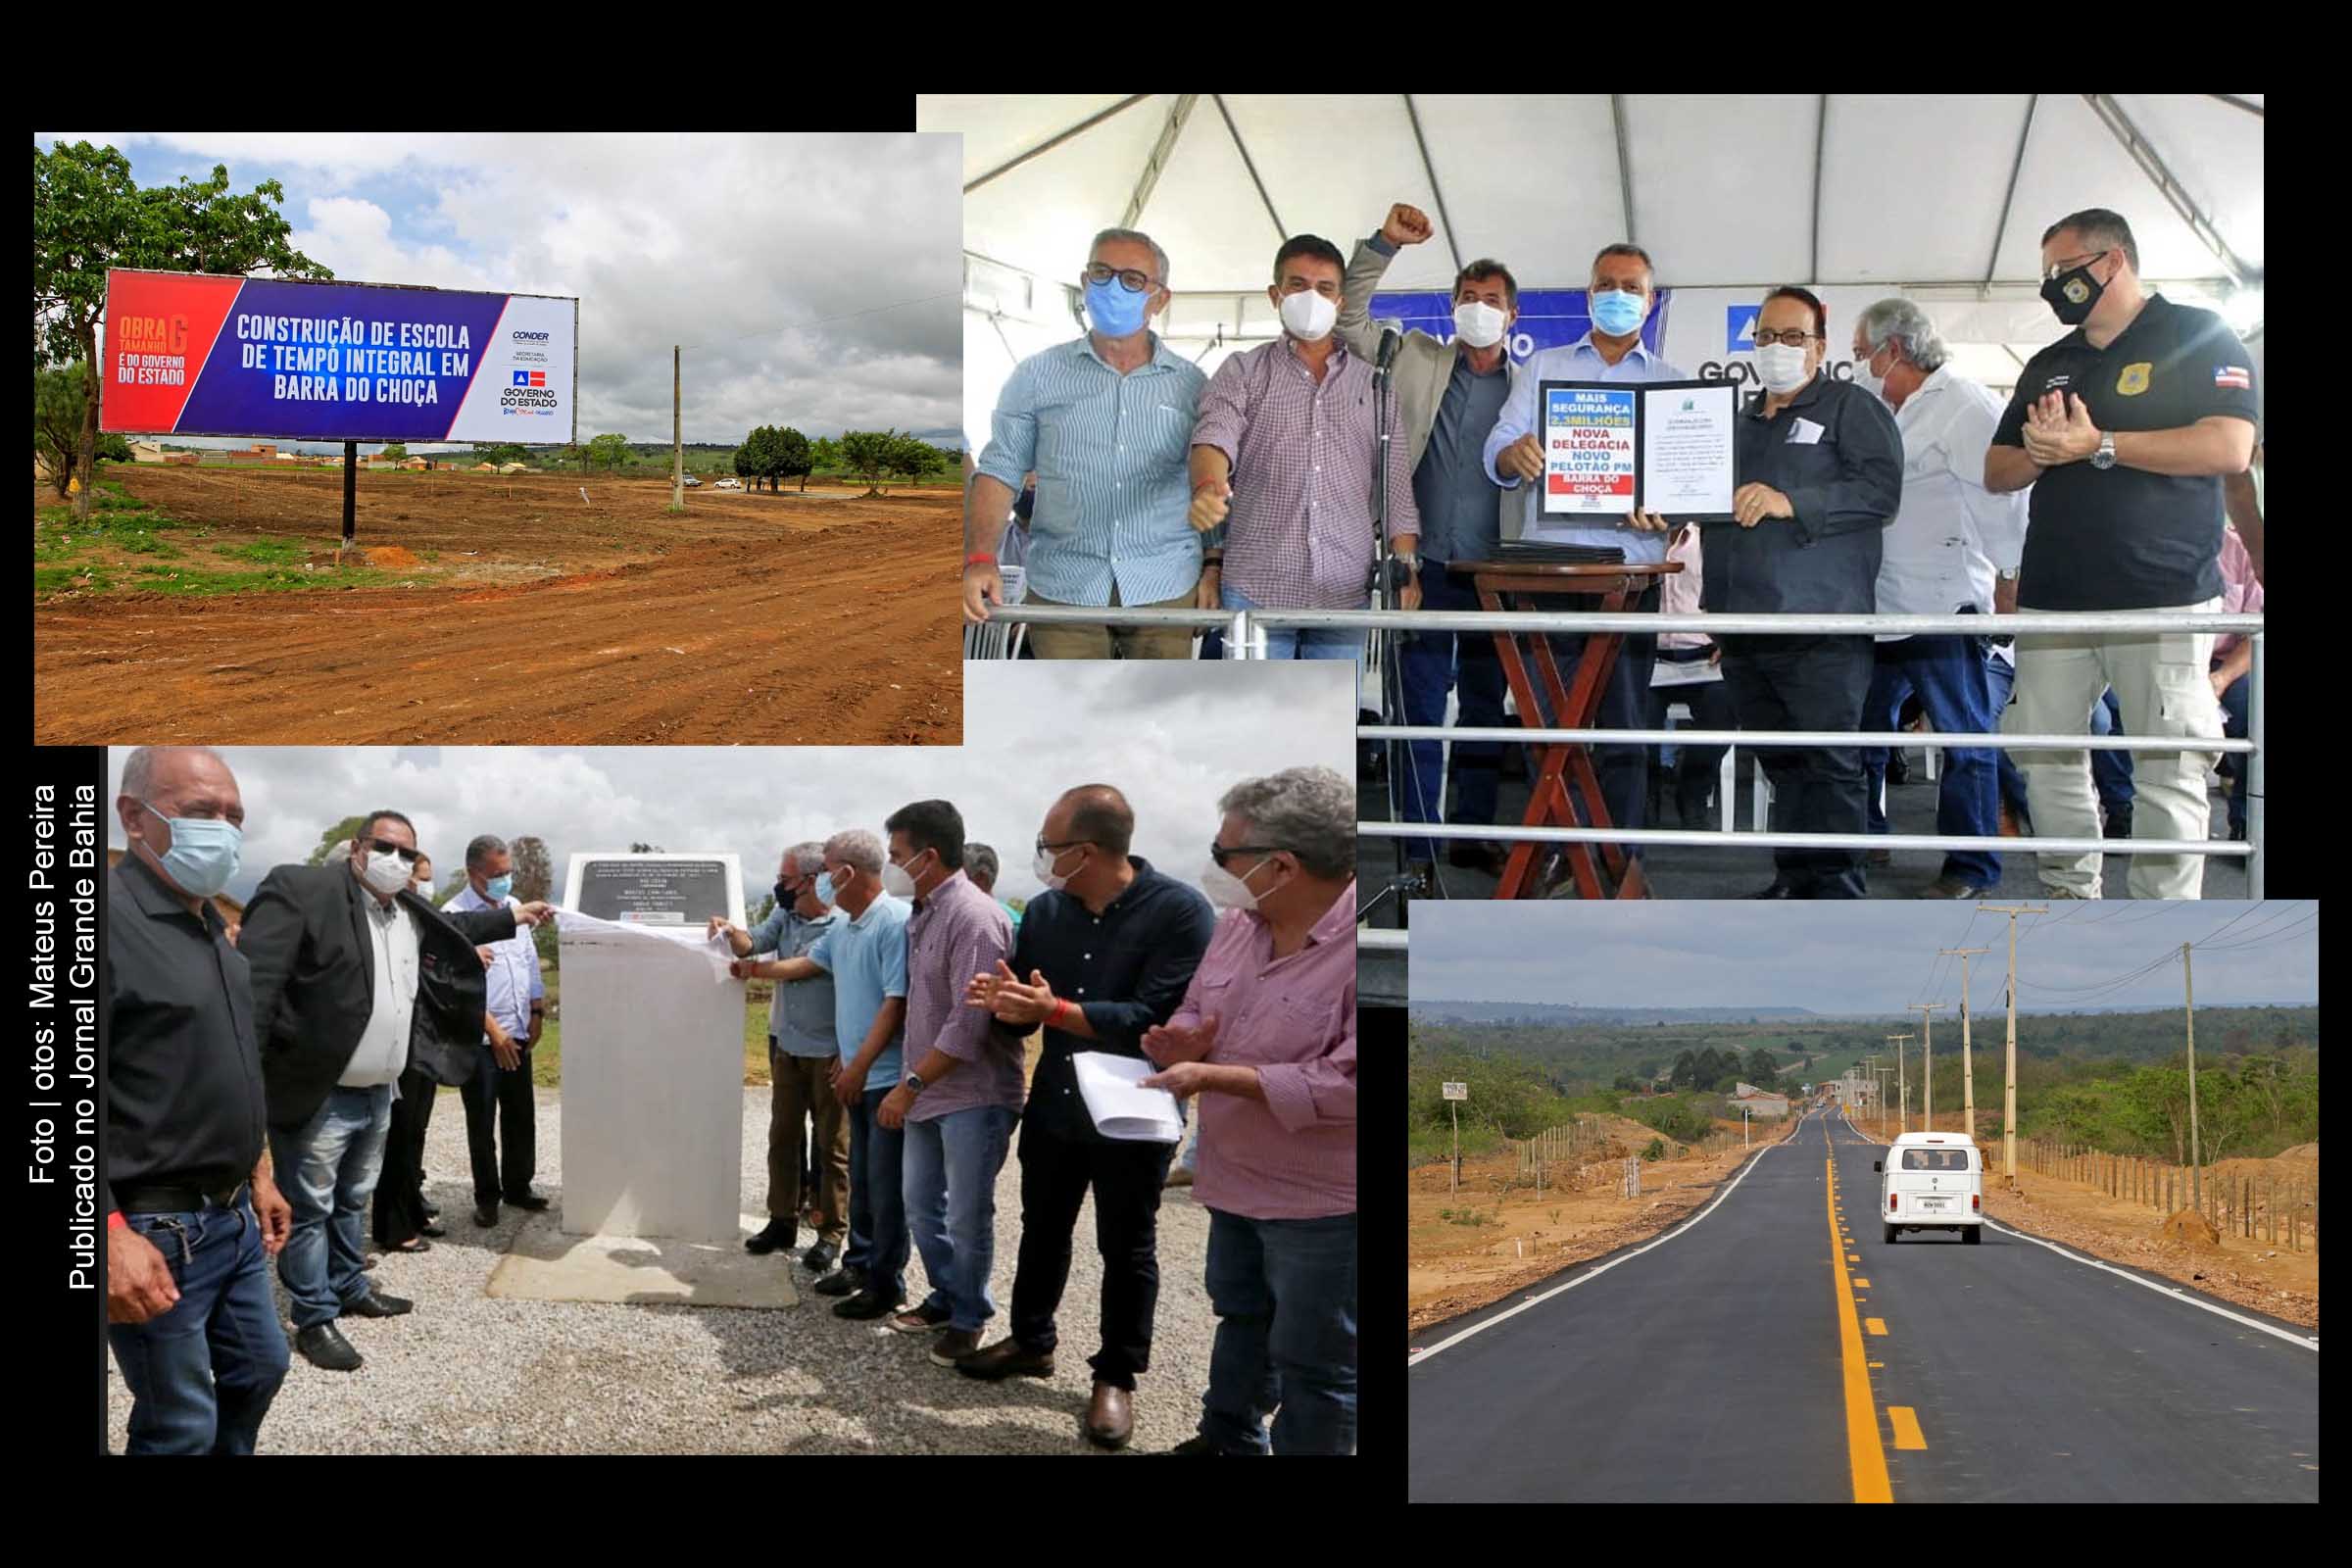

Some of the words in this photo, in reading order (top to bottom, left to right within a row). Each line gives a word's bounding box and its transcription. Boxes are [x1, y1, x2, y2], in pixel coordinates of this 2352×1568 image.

[120, 316, 167, 340] OBRA
[237, 314, 365, 349] CONSTRUÇÃO
[370, 321, 395, 347] DE
[401, 323, 470, 350] ESCOLA
[120, 339, 167, 355] TAMANHO
[170, 314, 189, 355] G
[513, 331, 550, 340] CONDER
[119, 352, 125, 367] É
[126, 354, 140, 367] DO
[141, 355, 185, 369] GOVERNO
[242, 344, 267, 369] DE
[273, 347, 339, 372] TEMPO
[346, 349, 436, 376] INTEGRAL
[441, 352, 469, 377] EM
[118, 367, 135, 383] DO
[137, 368, 185, 385] ESTADO
[274, 375, 339, 402] BARRA
[345, 377, 371, 402] DO
[375, 378, 438, 408] CHOÇA
[504, 388, 555, 399] GOVERNO
[501, 397, 516, 407] DO
[517, 398, 558, 408] ESTADO
[1575, 393, 1608, 404] MAIS
[1551, 403, 1631, 415] SEGURANÇA
[1572, 429, 1610, 439] NOVA
[1551, 439, 1631, 451] DELEGACIA
[1572, 451, 1611, 461] NOVO
[1613, 463, 1632, 472] PM
[1573, 484, 1613, 495] CHOÇA
